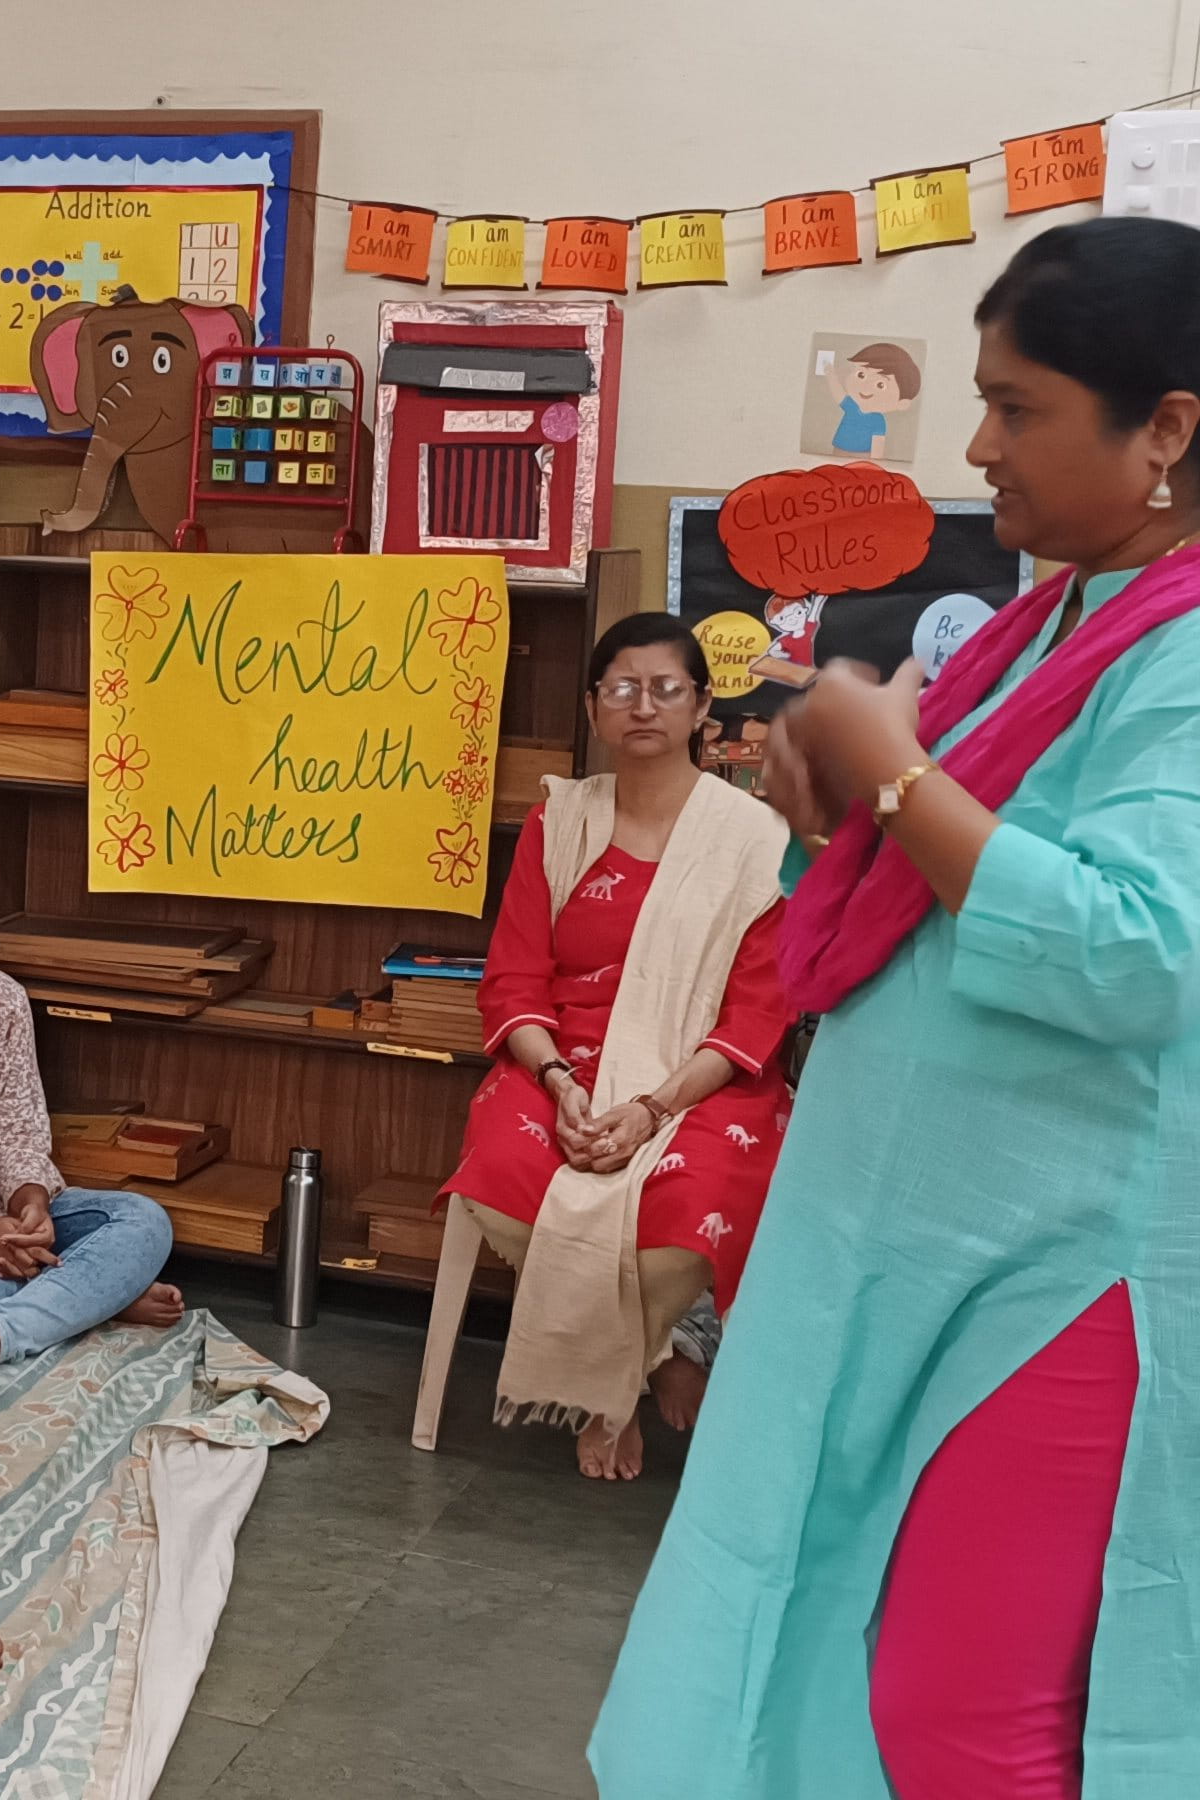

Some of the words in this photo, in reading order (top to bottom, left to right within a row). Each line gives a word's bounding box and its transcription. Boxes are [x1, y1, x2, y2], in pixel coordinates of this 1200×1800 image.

[1050, 135, 1084, 157] am
[1014, 156, 1100, 191] STRONG
[914, 181, 943, 199] am
[45, 190, 152, 220] Addition
[802, 205, 836, 224] am
[384, 220, 410, 238] am
[486, 227, 509, 243] am
[581, 229, 610, 248] am
[678, 223, 705, 238] am
[774, 226, 841, 255] BRAVE
[351, 238, 418, 263] SMART
[550, 246, 617, 272] LOVED
[213, 258, 229, 284] 2
[732, 478, 906, 532] Classroom
[774, 525, 879, 576] Rules
[699, 624, 756, 650] Raise
[933, 614, 965, 640] Be
[145, 579, 437, 705] Mental
[711, 650, 760, 667] your
[249, 712, 444, 793] health
[166, 783, 362, 878] Matters
